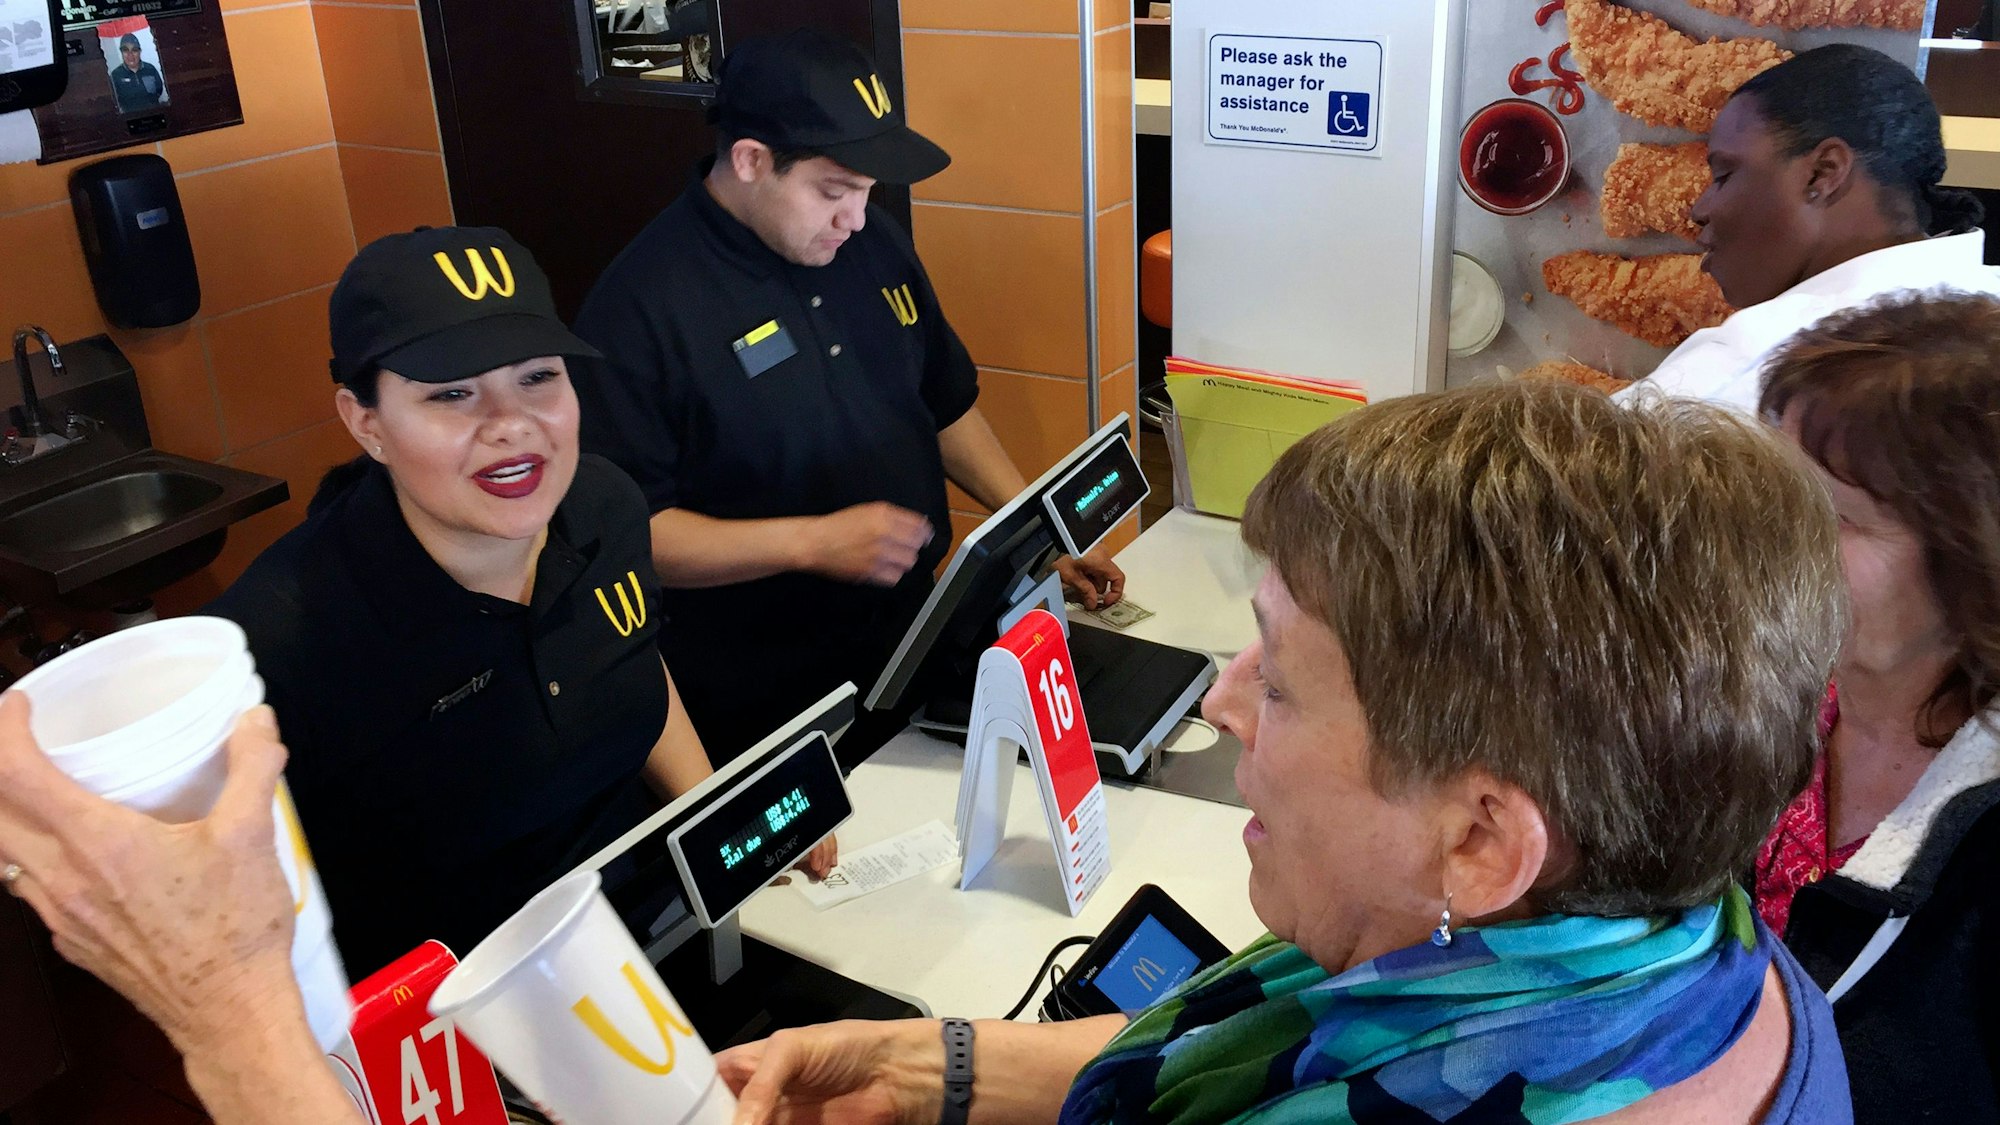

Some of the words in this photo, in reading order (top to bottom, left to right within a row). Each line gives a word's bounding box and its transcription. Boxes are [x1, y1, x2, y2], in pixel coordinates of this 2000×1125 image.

[1221, 47, 1278, 65] Please
[1283, 51, 1313, 67] ask
[1319, 53, 1347, 68] the
[1220, 74, 1294, 91] manager
[1300, 75, 1324, 91] for
[1220, 95, 1309, 114] assistance
[1038, 658, 1074, 742] 16
[746, 836, 762, 853] due
[400, 1015, 466, 1125] 47
